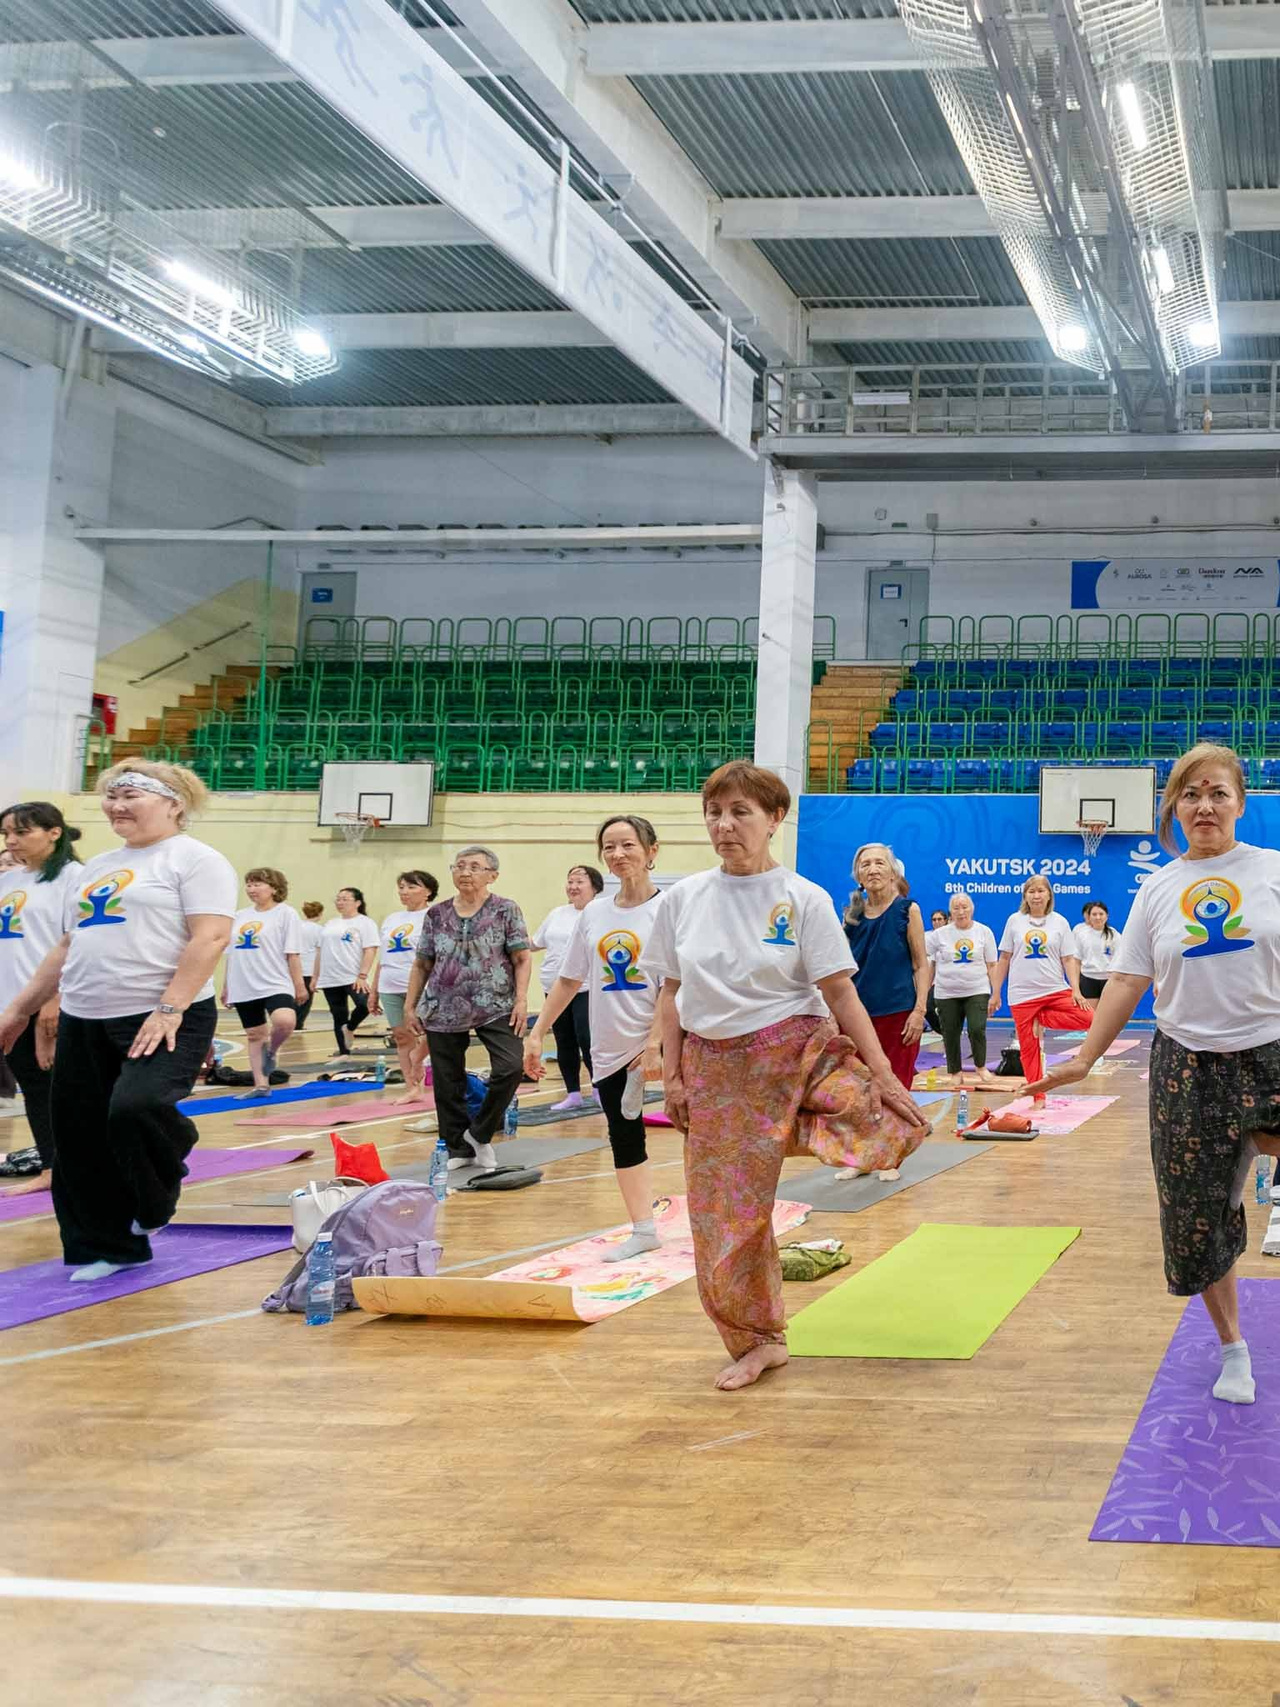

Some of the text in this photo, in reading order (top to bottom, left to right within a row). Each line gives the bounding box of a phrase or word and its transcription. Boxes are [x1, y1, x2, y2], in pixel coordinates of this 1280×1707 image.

[945, 858, 1091, 875] YAKUTSK 2024
[945, 882, 963, 893] 8th
[966, 882, 1011, 894] Children
[1053, 884, 1091, 894] Games
